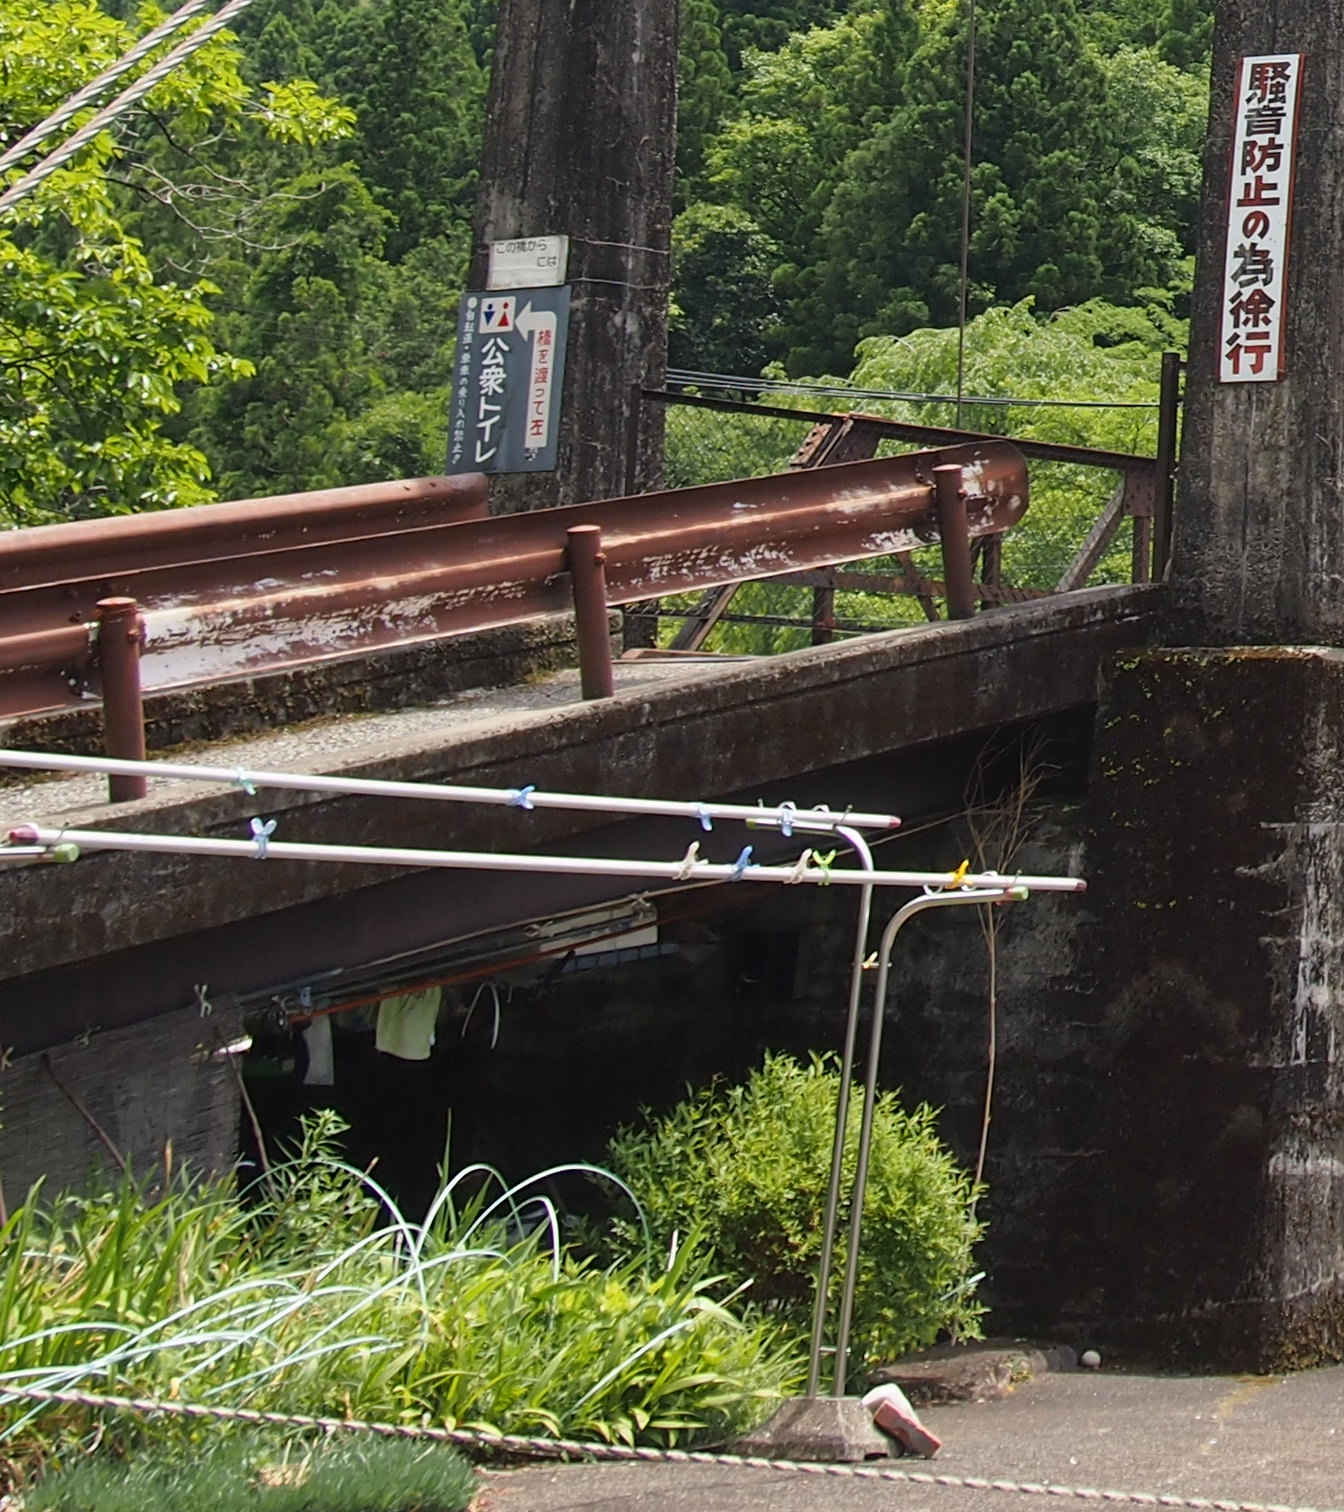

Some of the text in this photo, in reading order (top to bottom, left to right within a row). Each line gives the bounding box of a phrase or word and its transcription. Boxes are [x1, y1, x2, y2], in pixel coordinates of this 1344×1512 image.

[496, 239, 547, 254] この橋から
[1225, 61, 1291, 375] 騒音防止の為徐行
[475, 337, 510, 463] 公衆トイレ
[530, 329, 552, 436] 橋を渡って左
